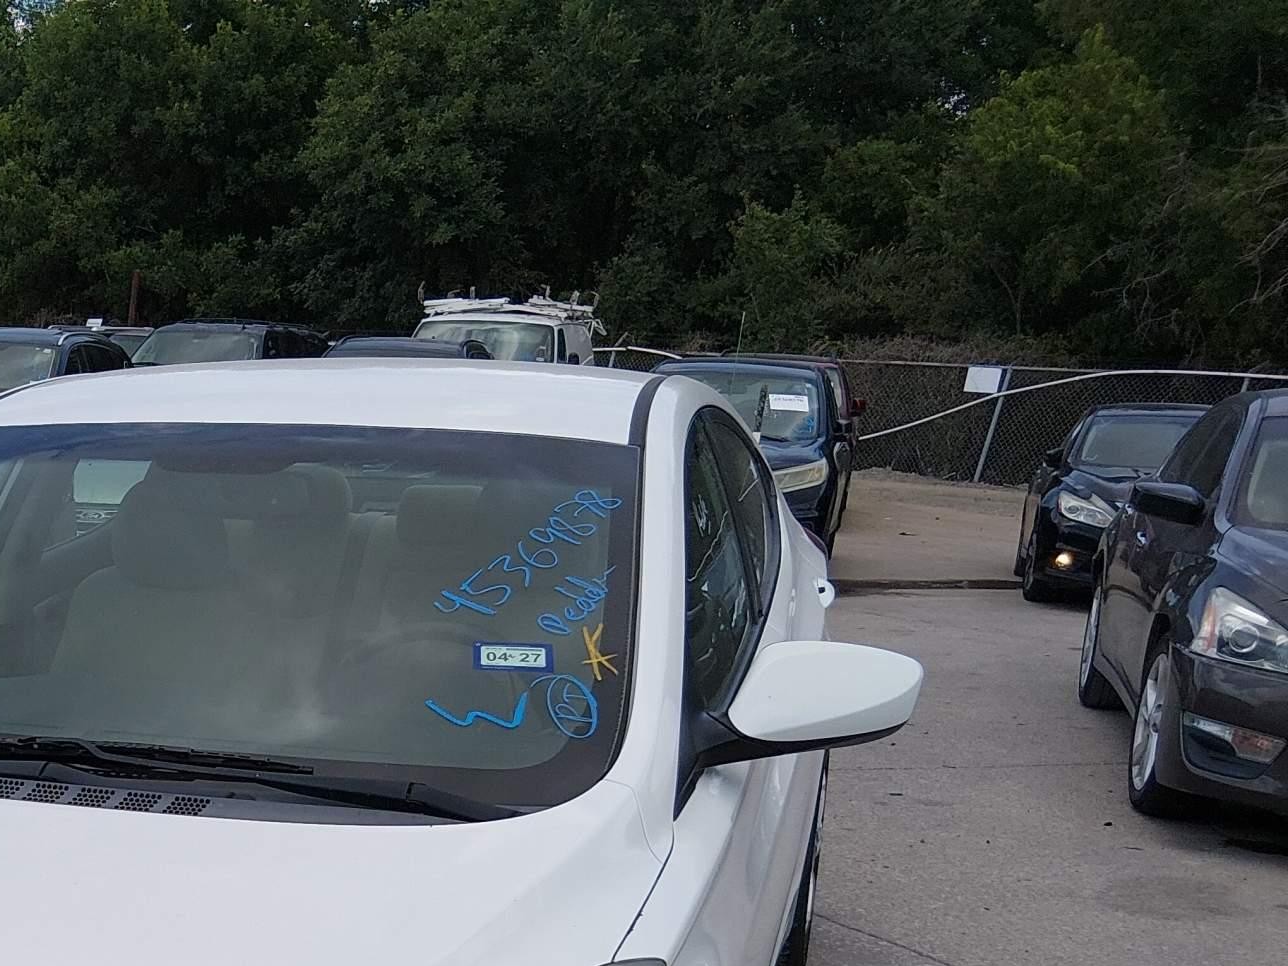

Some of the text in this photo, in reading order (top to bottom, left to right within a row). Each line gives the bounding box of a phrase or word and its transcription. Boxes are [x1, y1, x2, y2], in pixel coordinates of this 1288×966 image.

[433, 489, 622, 615] 45369878
[486, 651, 542, 663] 04 27
